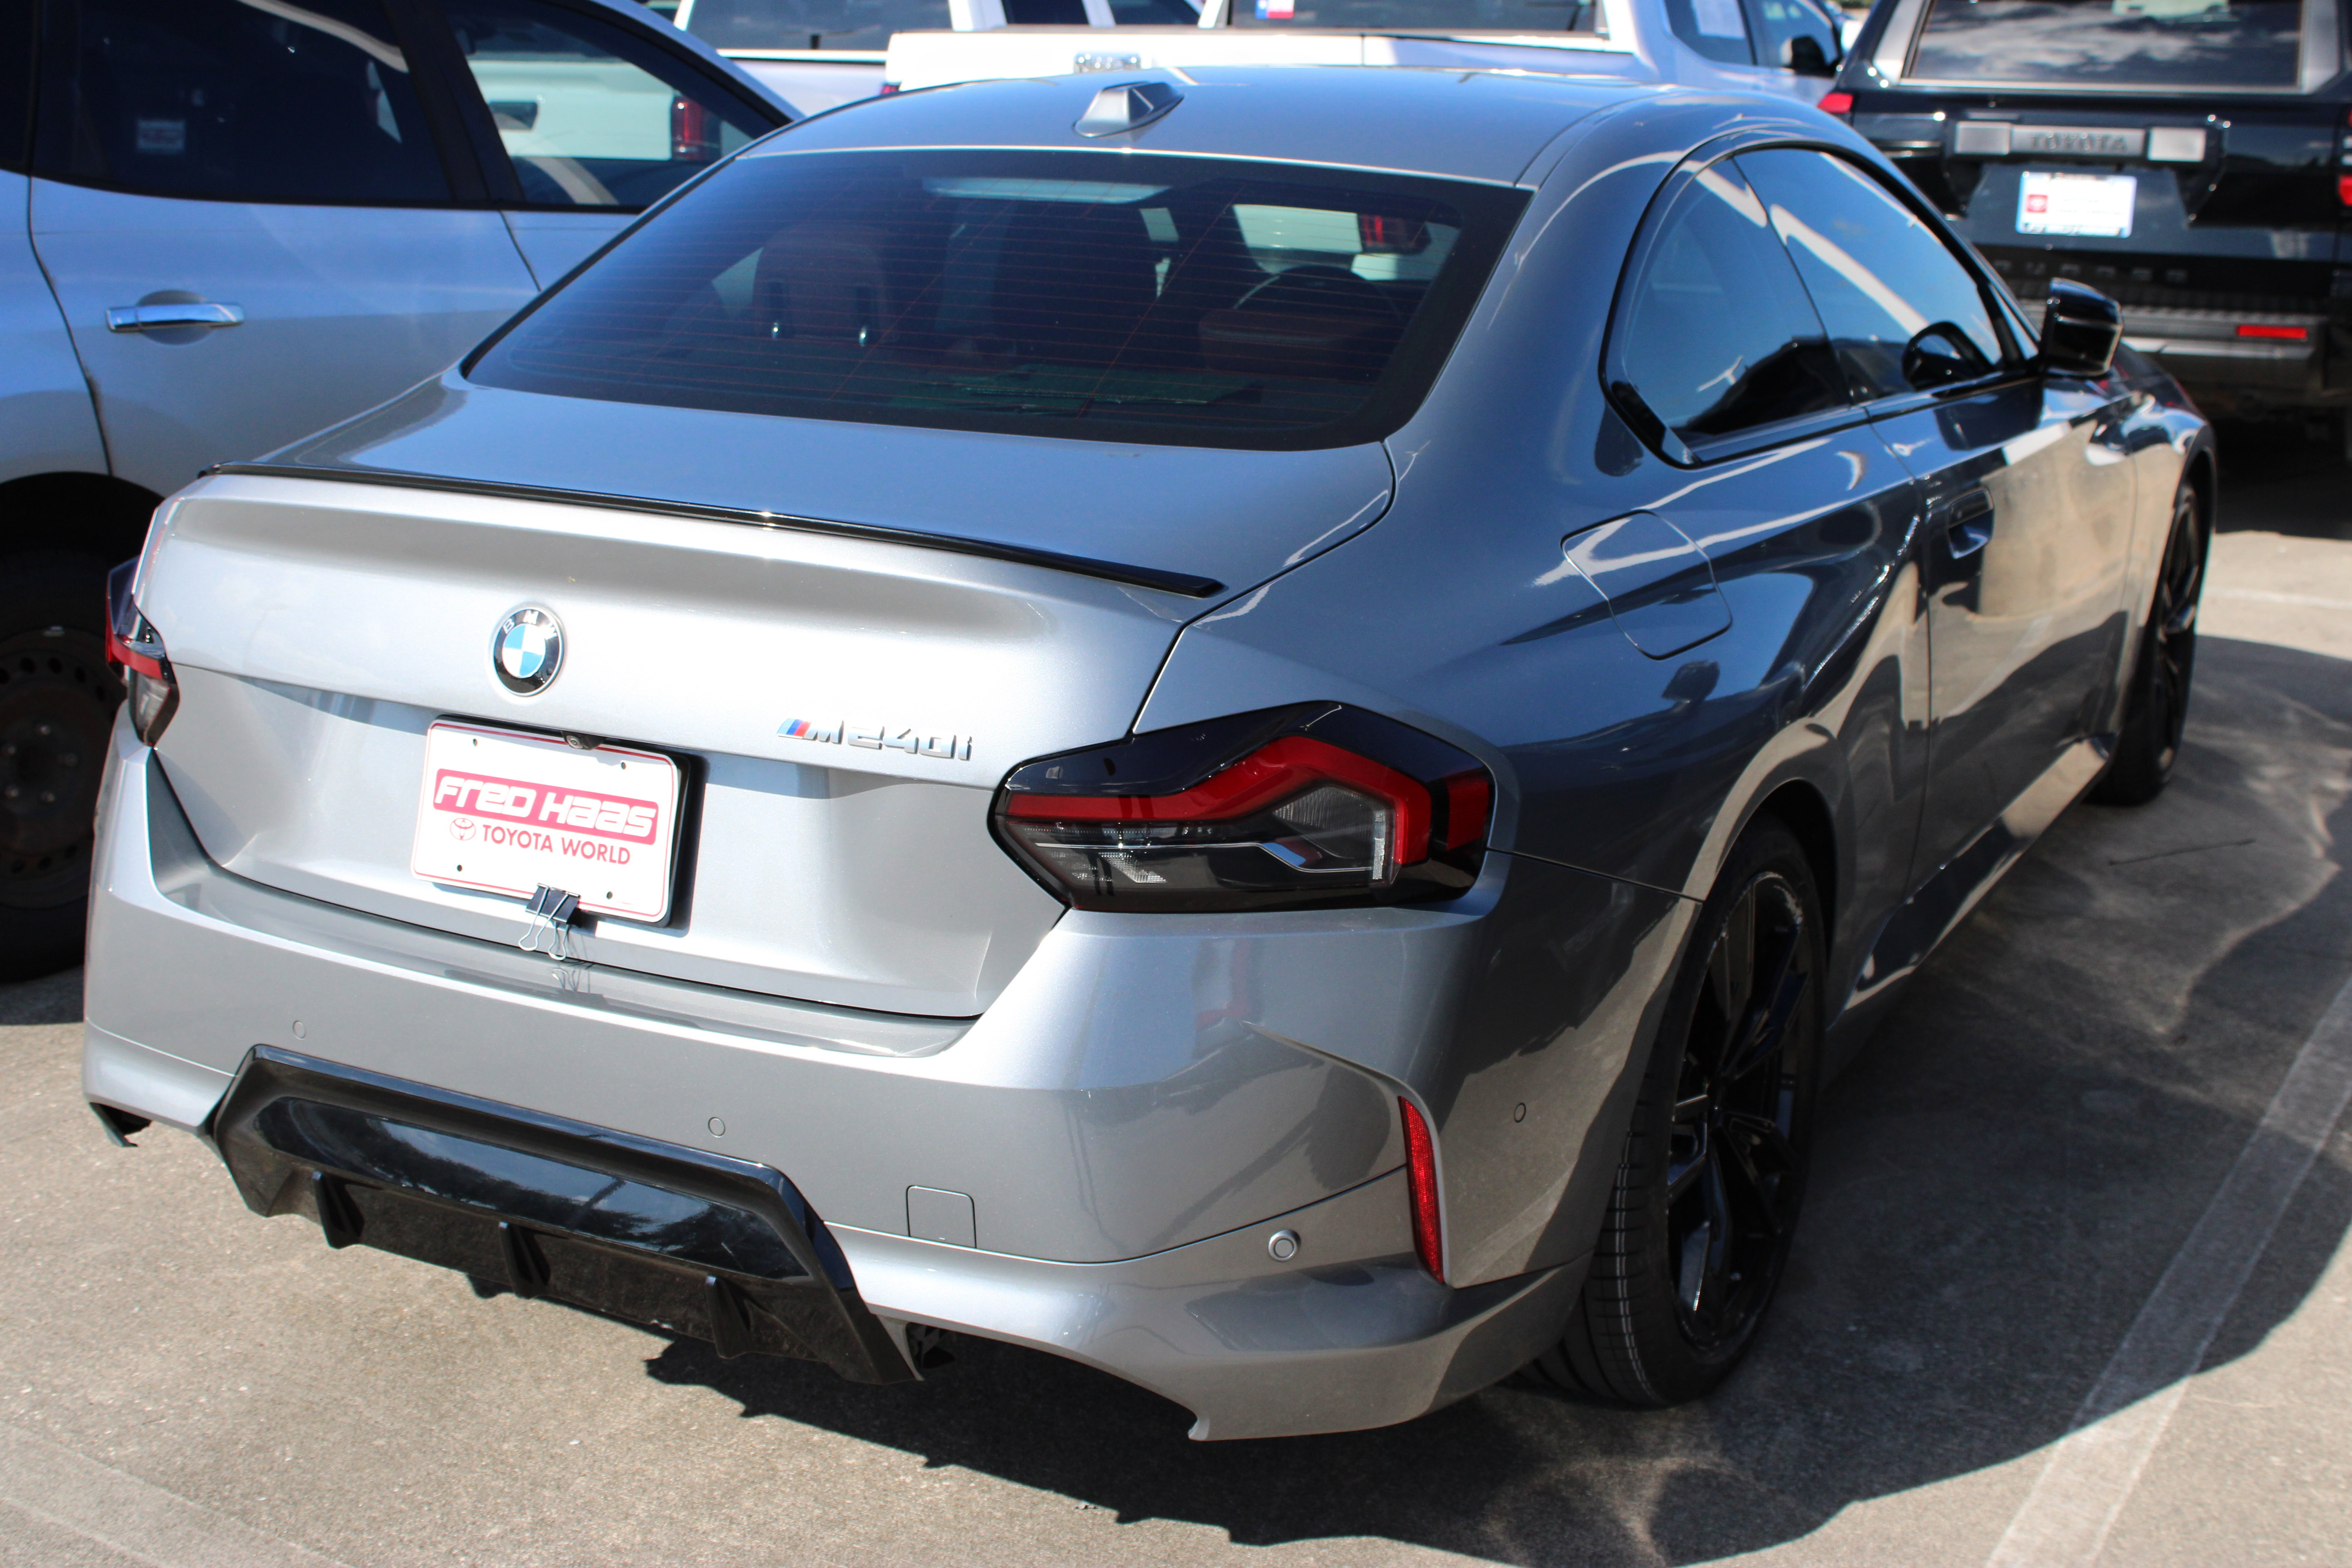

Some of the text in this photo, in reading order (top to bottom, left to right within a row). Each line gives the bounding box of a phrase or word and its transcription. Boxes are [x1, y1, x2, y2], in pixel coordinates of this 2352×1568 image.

[2030, 131, 2126, 152] TOYOTA
[503, 610, 558, 640] BMW
[482, 824, 630, 865] TOYOTA WORLD
